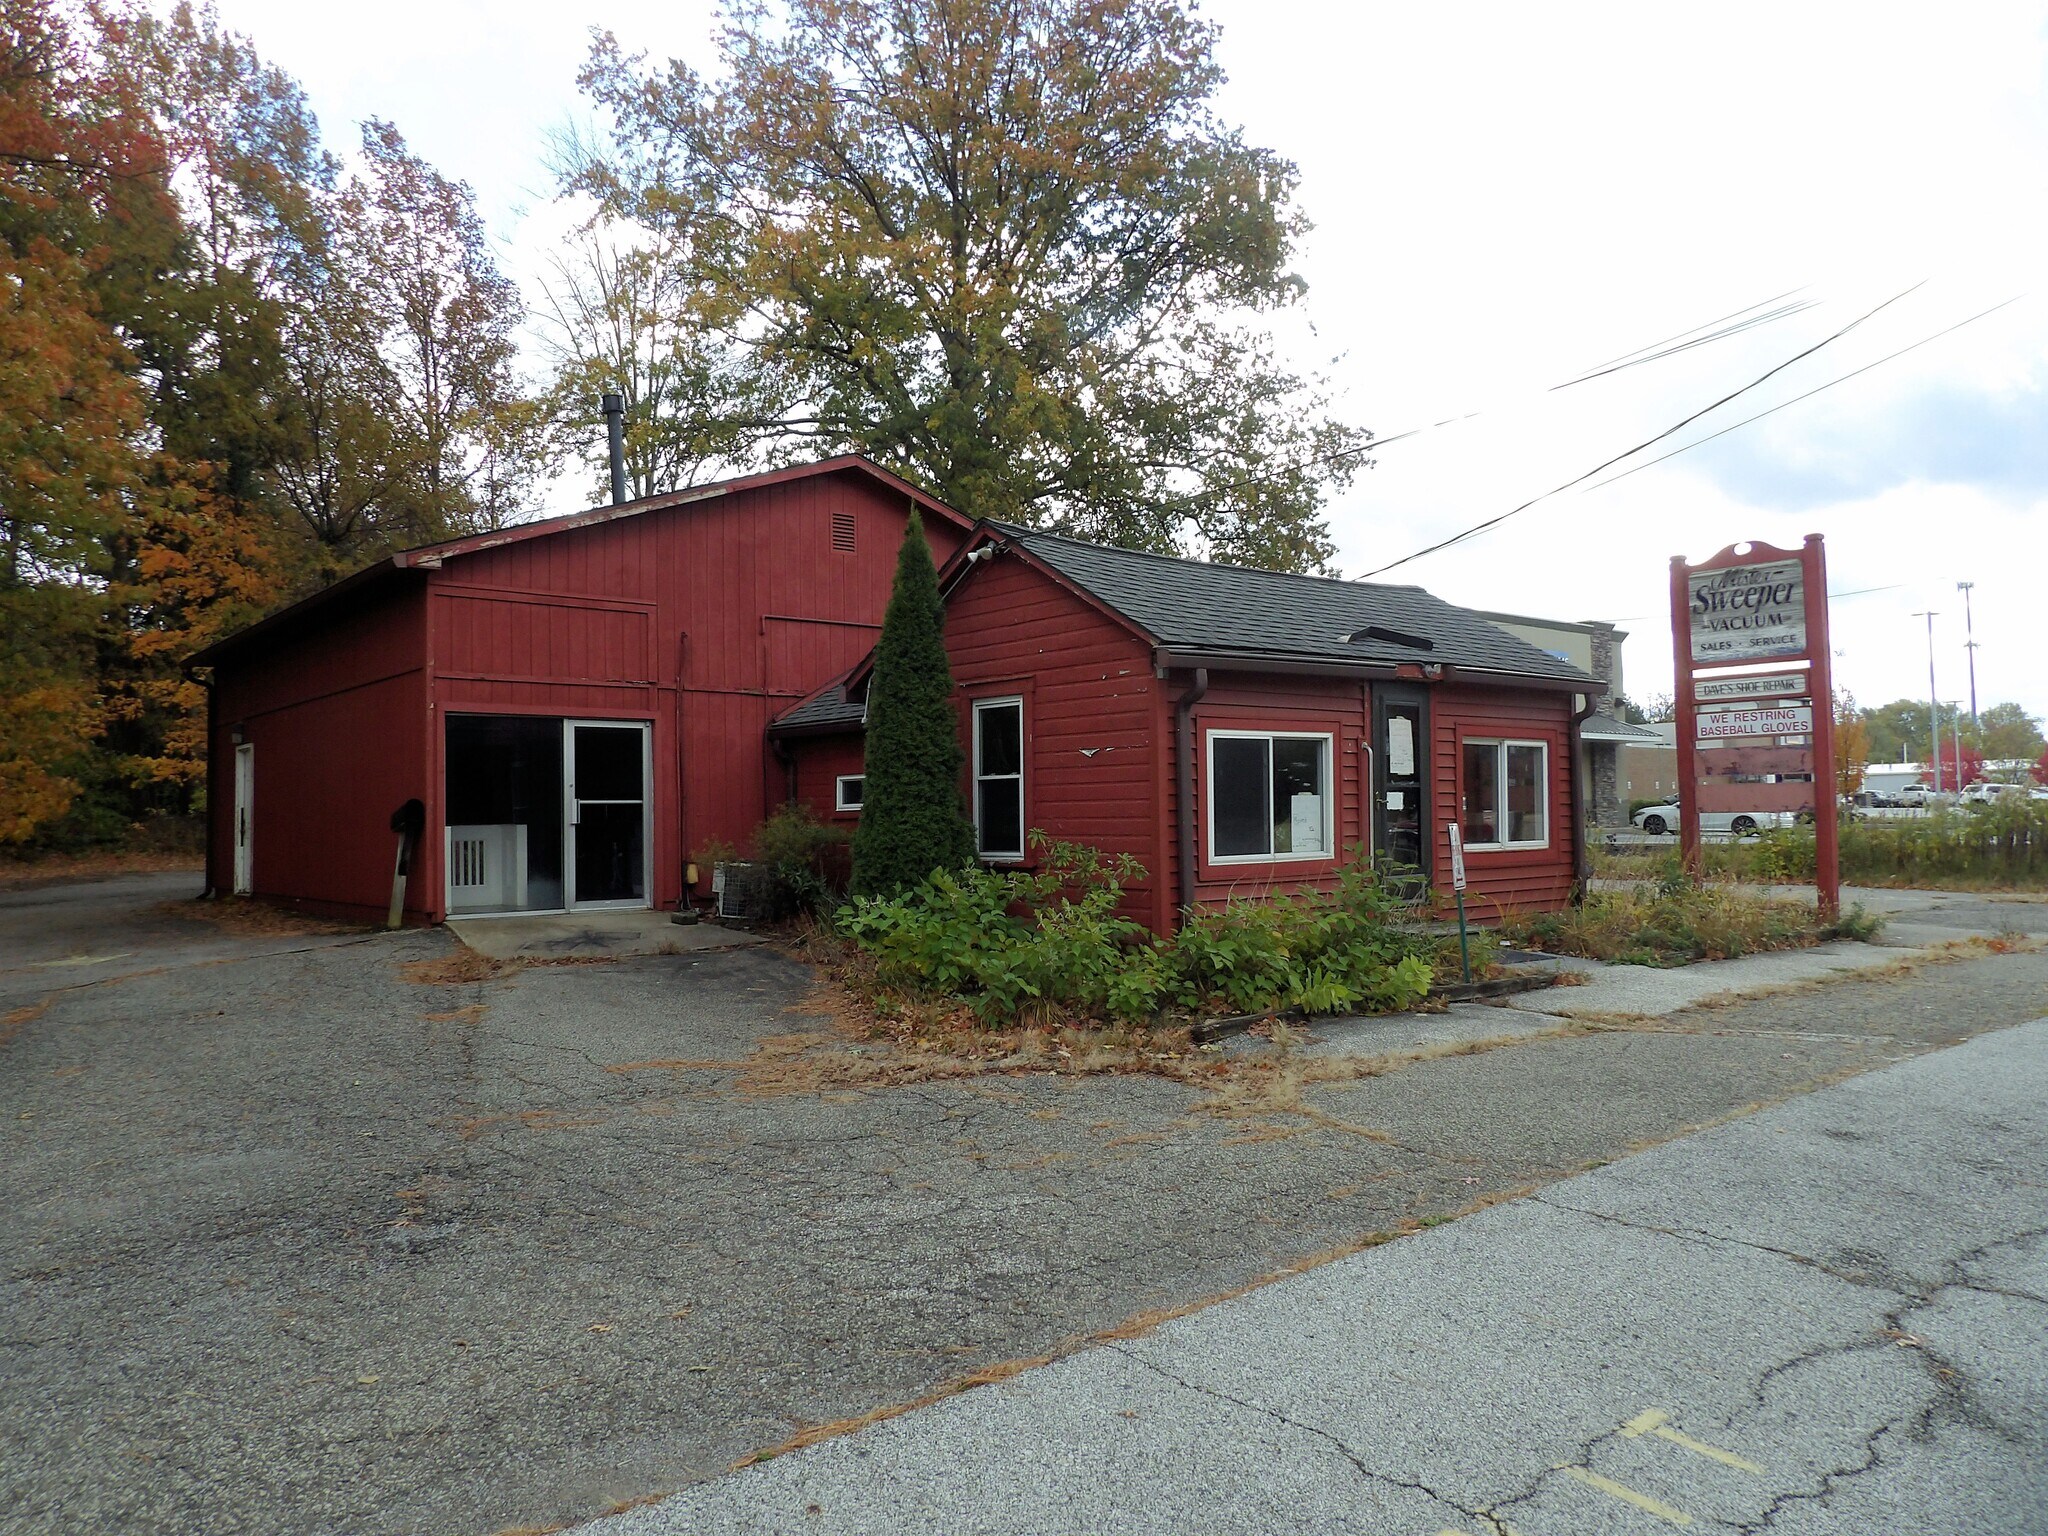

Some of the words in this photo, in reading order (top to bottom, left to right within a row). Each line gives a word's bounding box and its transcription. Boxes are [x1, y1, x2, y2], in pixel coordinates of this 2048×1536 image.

[1693, 582, 1794, 614] Sweeper
[1700, 641, 1732, 652] SALES
[1749, 635, 1797, 647] SERVICE
[1704, 683, 1733, 696] DAVE'S
[1736, 681, 1760, 693] SHOE
[1763, 679, 1796, 691] REPAIR
[1710, 713, 1728, 724] WE
[1734, 709, 1796, 722] RESTRING
[1701, 724, 1757, 737] BASEBALL
[1761, 720, 1808, 733] GLOVES
